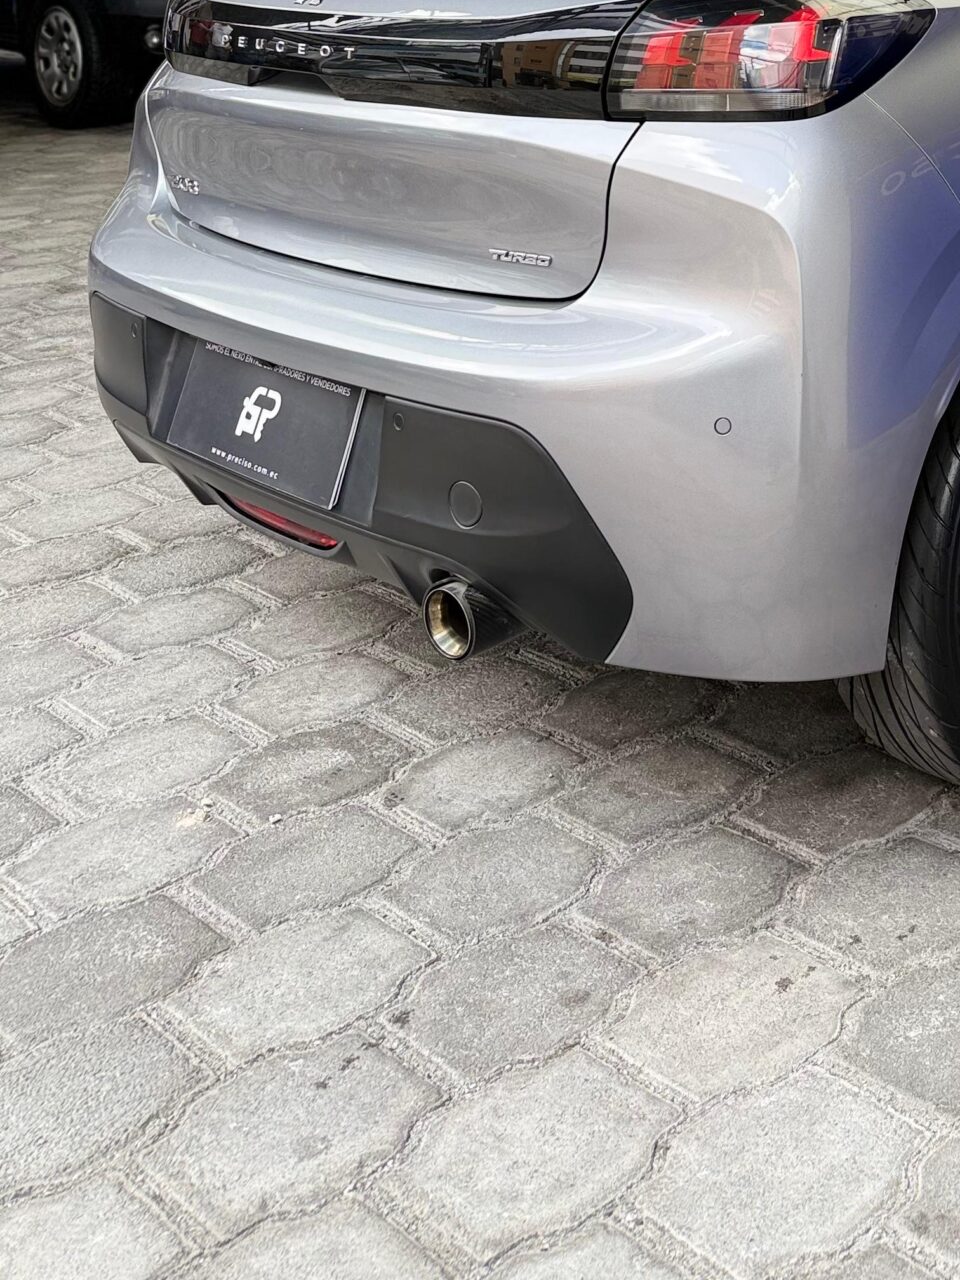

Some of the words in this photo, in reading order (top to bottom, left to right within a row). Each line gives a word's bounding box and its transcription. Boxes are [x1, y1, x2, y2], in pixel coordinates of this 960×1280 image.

[221, 34, 355, 60] PEUGEOT
[488, 248, 553, 268] TURBO
[310, 376, 352, 397] VENDEDORES
[211, 446, 279, 480] www.preciso.com.ec
